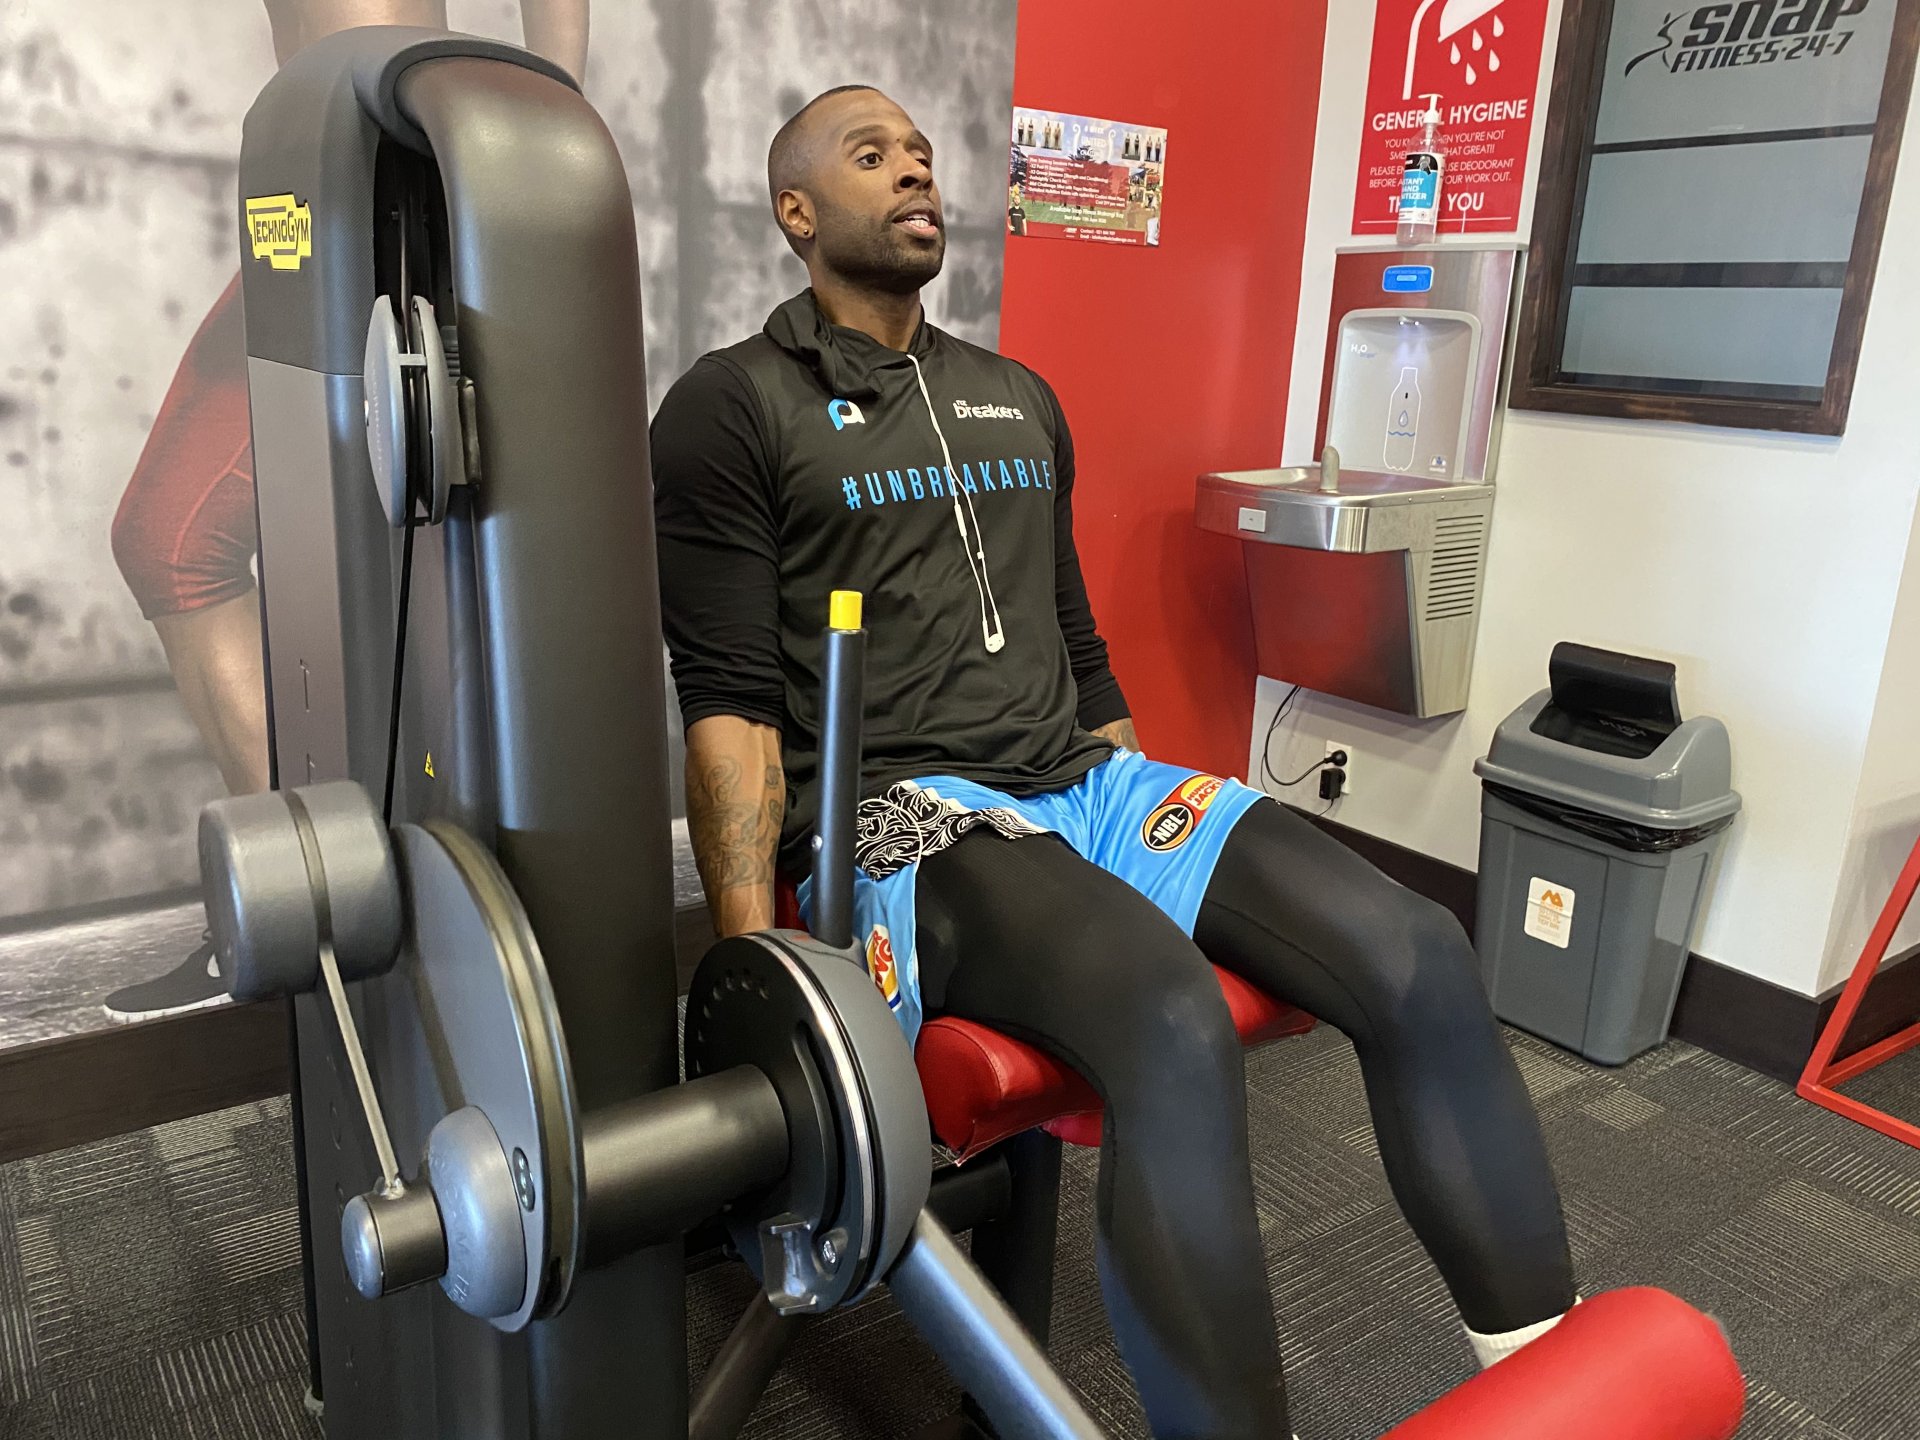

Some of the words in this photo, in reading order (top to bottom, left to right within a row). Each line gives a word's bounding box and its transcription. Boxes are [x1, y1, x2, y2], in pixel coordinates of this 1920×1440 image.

[1372, 108, 1445, 131] GENERL
[1449, 98, 1528, 125] HYGIENE
[1385, 139, 1401, 148] YOU
[1455, 131, 1485, 143] YOU'RE
[1487, 130, 1505, 140] NOT
[1390, 151, 1407, 160] SME
[1370, 166, 1395, 175] PLEASE
[1460, 158, 1514, 171] DEODORANT
[1369, 178, 1396, 188] BEFORE
[1444, 175, 1463, 184] OUR
[1465, 173, 1490, 183] WORK
[1492, 171, 1512, 182] OUT.
[1447, 192, 1485, 212] YOU
[249, 206, 310, 255] TECHNOGYM
[953, 403, 1023, 420] breakers
[841, 458, 1052, 510] #UNBREAKABLE
[1152, 814, 1186, 842] NBL
